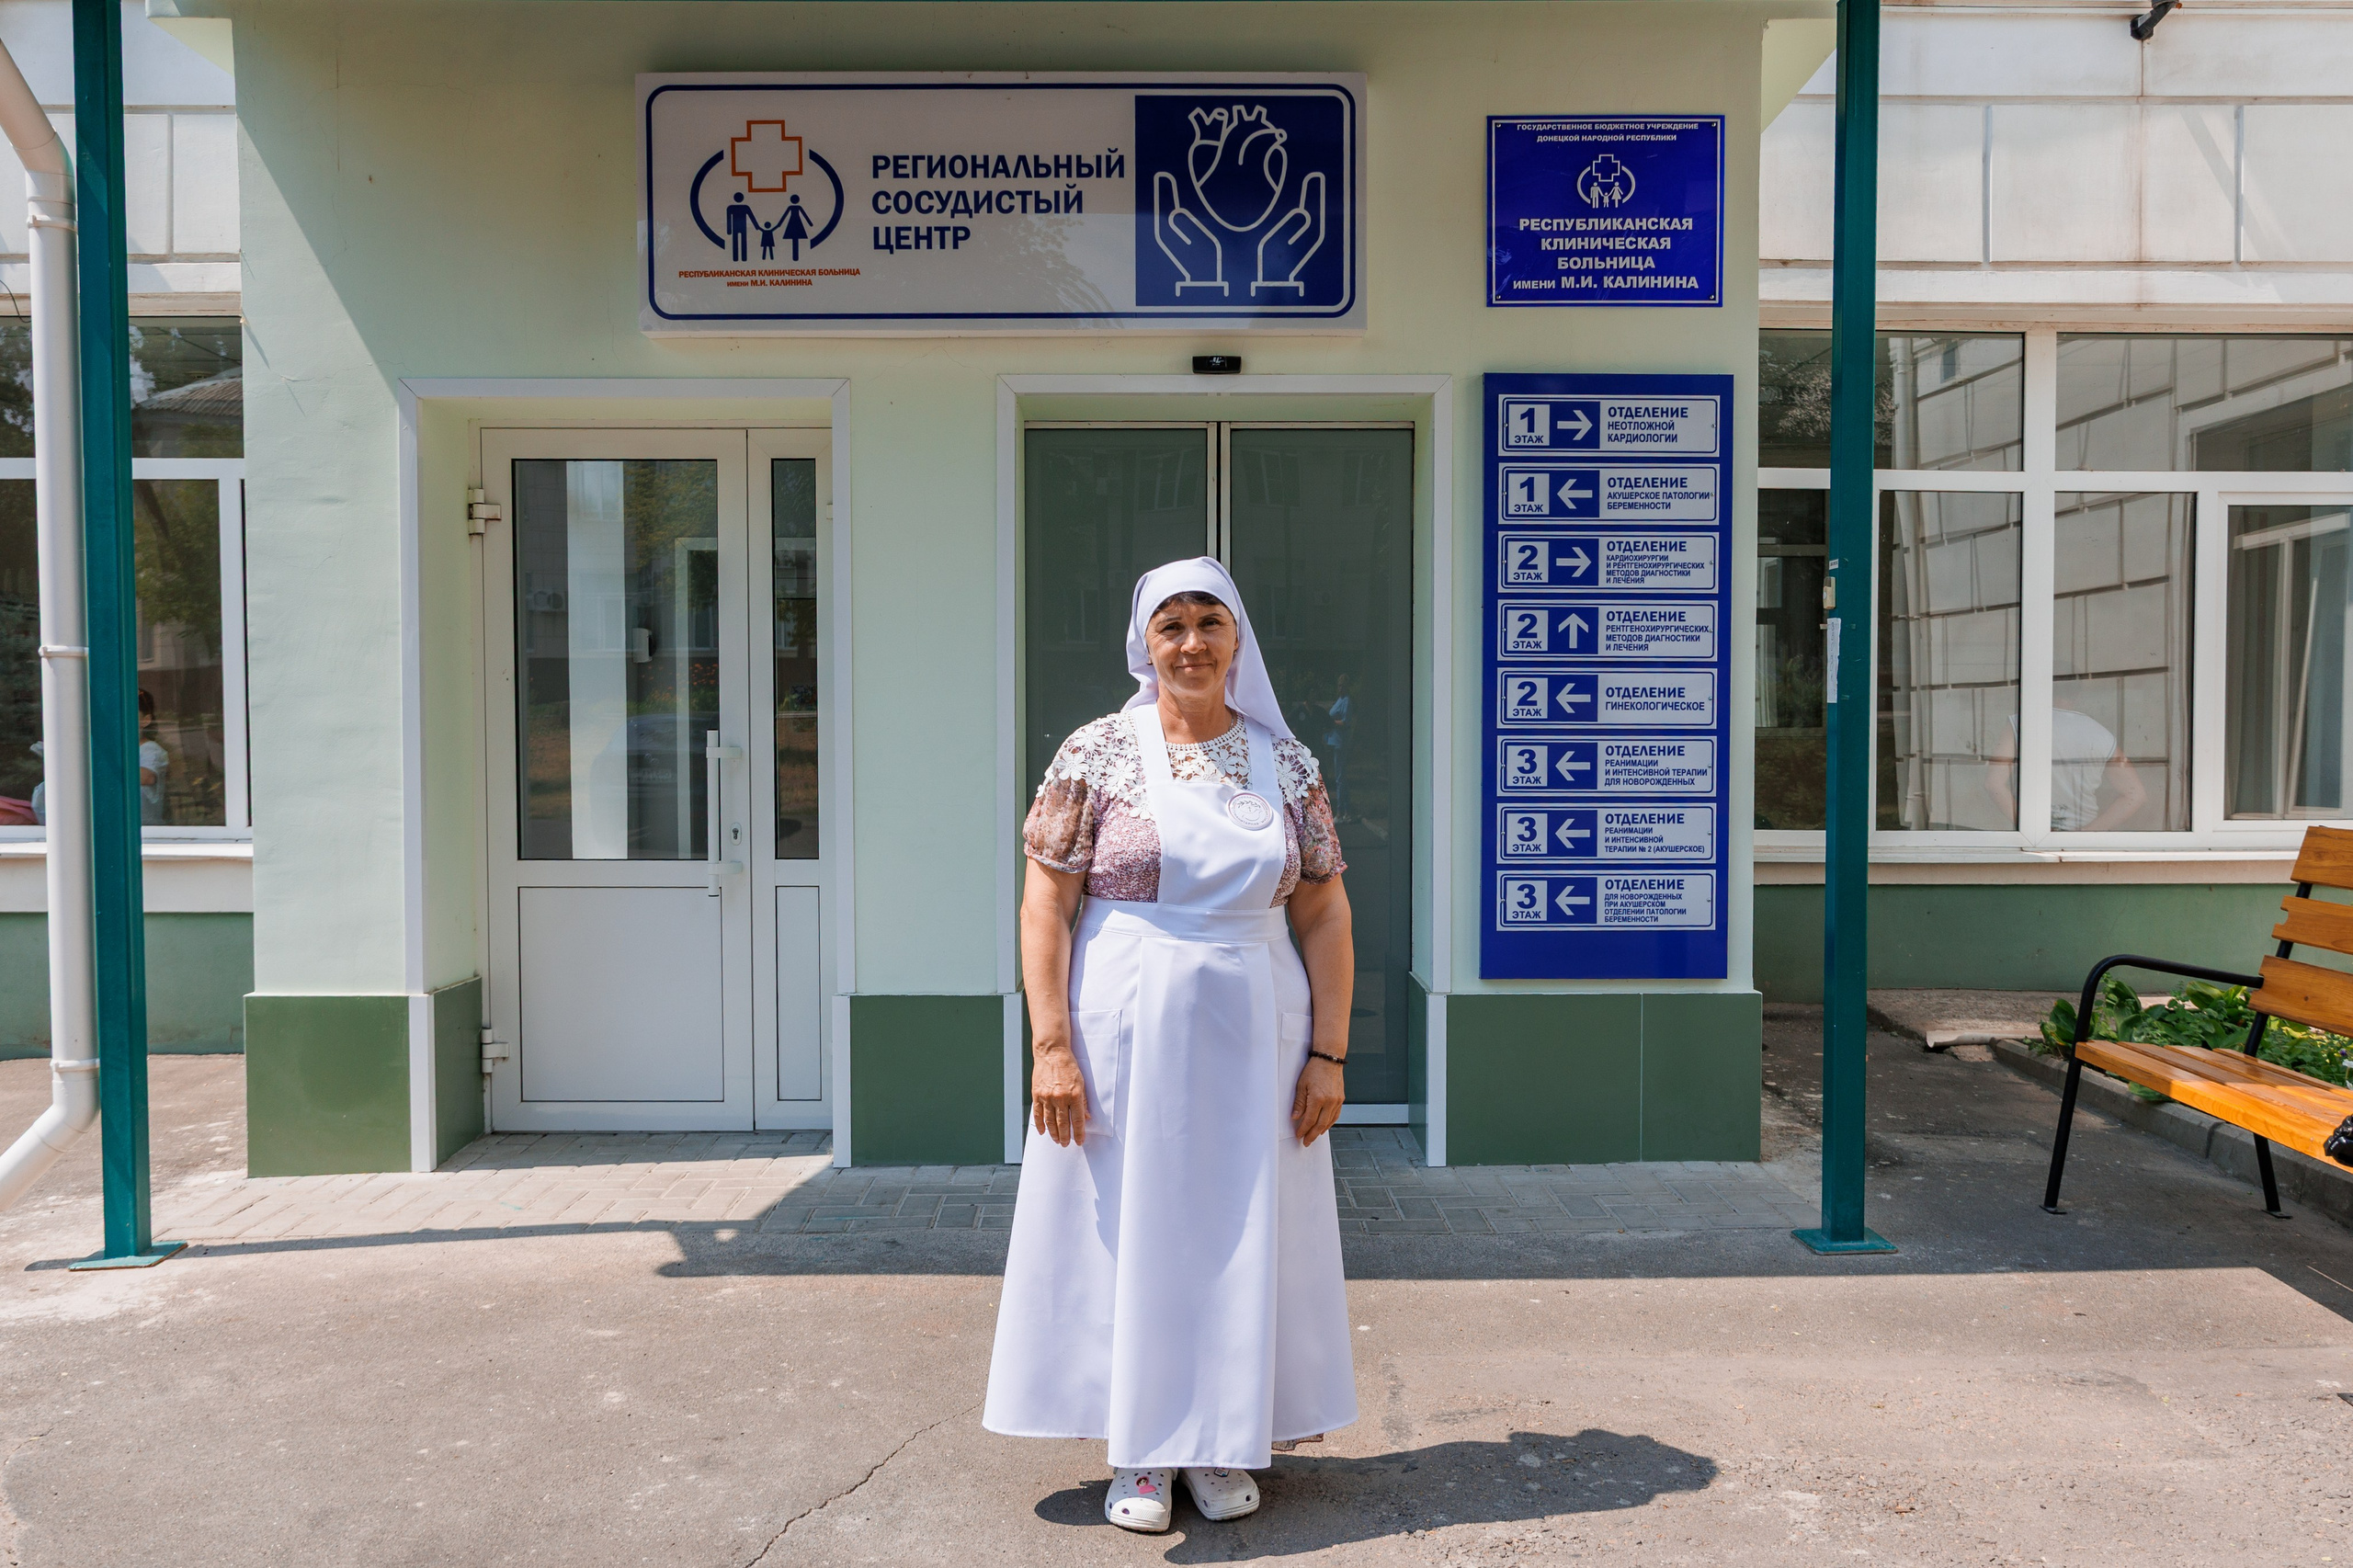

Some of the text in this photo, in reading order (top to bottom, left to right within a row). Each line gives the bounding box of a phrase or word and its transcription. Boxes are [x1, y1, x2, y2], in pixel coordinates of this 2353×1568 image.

[1537, 134, 1580, 142] ДОНЕЦКОЙ
[1581, 134, 1625, 142] НАРОДНОЙ
[872, 148, 1125, 180] РЕГИОНАЛЬНЫЙ
[872, 184, 1084, 220] СОСУДИСТЫЙ
[1519, 218, 1693, 232] РЕСПУБЛИКАНСКАЯ
[872, 225, 971, 255] ЦЕНТР
[1540, 237, 1671, 251] КЛИНИЧЕСКАЯ
[1557, 256, 1655, 270] БОЛЬНИЦА
[678, 268, 860, 278] РЕСПУБЛИКАНСКАЯ КЛИНИЧЕСКАЯ БОЛЬНИЦА
[769, 278, 813, 287] КАЛИНИНА
[1513, 276, 1699, 290] ИМЕНИ М.И. КАЛИНИНА
[1608, 406, 1688, 419] ОТДЕЛЕНИЕ
[1519, 408, 1536, 433] 1
[1608, 420, 1675, 431] НЕОТЛОЖНОЙ
[1514, 435, 1544, 445] ЭТАЖ
[1608, 433, 1677, 444] КАРДИОЛОГИИ
[1607, 477, 1688, 490] ОТДЕЛЕНИЕ
[1519, 477, 1536, 503] 1
[1607, 491, 1711, 500] АКУШЕРСКОЕ ПАТОЛОГИИ
[1514, 505, 1543, 514] ЭТАЖ
[1607, 502, 1671, 510] БЕРЕМЕННОСТИ
[1606, 540, 1687, 553] ОТДЕЛЕНИЕ
[1518, 545, 1539, 570] 2
[1606, 554, 1669, 562] КАРДИОХИРУРГИИ
[1612, 562, 1705, 570] РЕНТГЕНОХИРУРГИЧЕСКИХ
[1513, 572, 1542, 581] ЭТАЖ
[1606, 611, 1686, 624] ОТДЕЛЕНИЕ
[1517, 613, 1538, 639] 2
[1606, 624, 1710, 633] РЕНТГЕНОХИРУРГИЧЕСКИХ
[1606, 634, 1700, 643] МЕТОДОВ ДИАГНОСТИКИ
[1512, 641, 1542, 650] ЭТАЖ
[1606, 643, 1649, 652] И ЛЕЧЕНИЯ
[1517, 681, 1538, 706] 2
[1606, 687, 1686, 699] ОТДЕЛЕНИЕ
[1606, 701, 1705, 711] ГИНЕКОЛОГИЧЕСКОЕ
[1512, 708, 1542, 717] ЭТАЖ
[1605, 745, 1686, 757] ОТДЕЛЕНИЕ
[1517, 749, 1538, 775] 3
[1605, 759, 1659, 767] РЕАНИМАЦИИ
[1612, 767, 1670, 777] ИНТЕНСИВНОЙ
[1672, 768, 1708, 777] ТЕРАПИИ
[1512, 776, 1541, 785] ЭТАЖ
[1604, 778, 1695, 787] ДЛЯ НОВОРОЖДЕННЫХ
[1605, 813, 1685, 825] ОТДЕЛЕНИЕ
[1517, 816, 1538, 842] 3
[1604, 826, 1654, 835] РЕАНИМАЦИИ
[1611, 835, 1664, 844] ИНТЕНСИВНОЙ
[1512, 844, 1541, 853] ЭТАЖ
[1604, 845, 1637, 853] ТЕРАПИИ
[1647, 845, 1652, 853] 2
[1654, 845, 1705, 854] (АКУШЕРСКОЕ)
[1605, 879, 1685, 892] ОТДЕЛЕНИЕ
[1517, 883, 1537, 909] 3
[1604, 892, 1683, 901] ДЛЯ НОВОРОЖДЕННЫХ
[1512, 911, 1541, 920] ЭТАЖ
